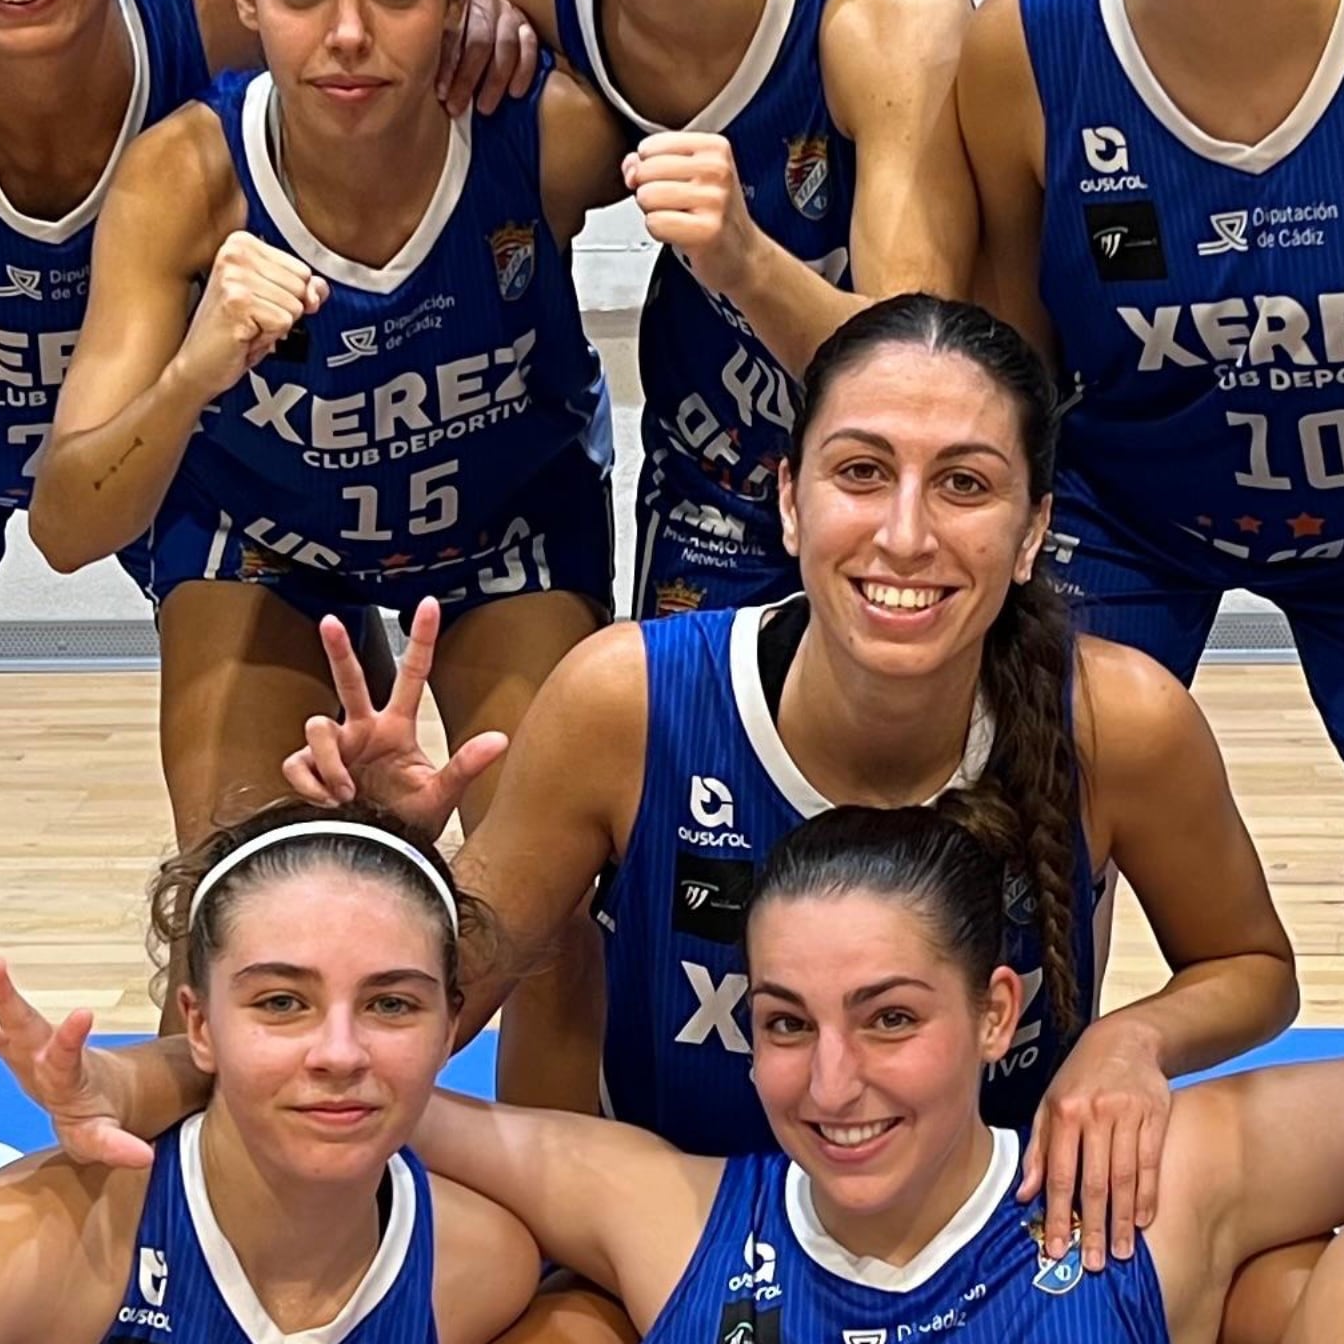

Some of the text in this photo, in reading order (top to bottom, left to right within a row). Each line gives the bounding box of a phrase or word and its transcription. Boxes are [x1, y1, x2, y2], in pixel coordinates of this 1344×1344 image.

[1080, 174, 1149, 194] austral
[1252, 201, 1339, 225] Diputación
[1258, 227, 1325, 249] de Cádiz
[242, 328, 537, 450] XEREZ
[302, 445, 381, 470] CLUB
[340, 459, 460, 542] 15
[678, 826, 752, 849] austral
